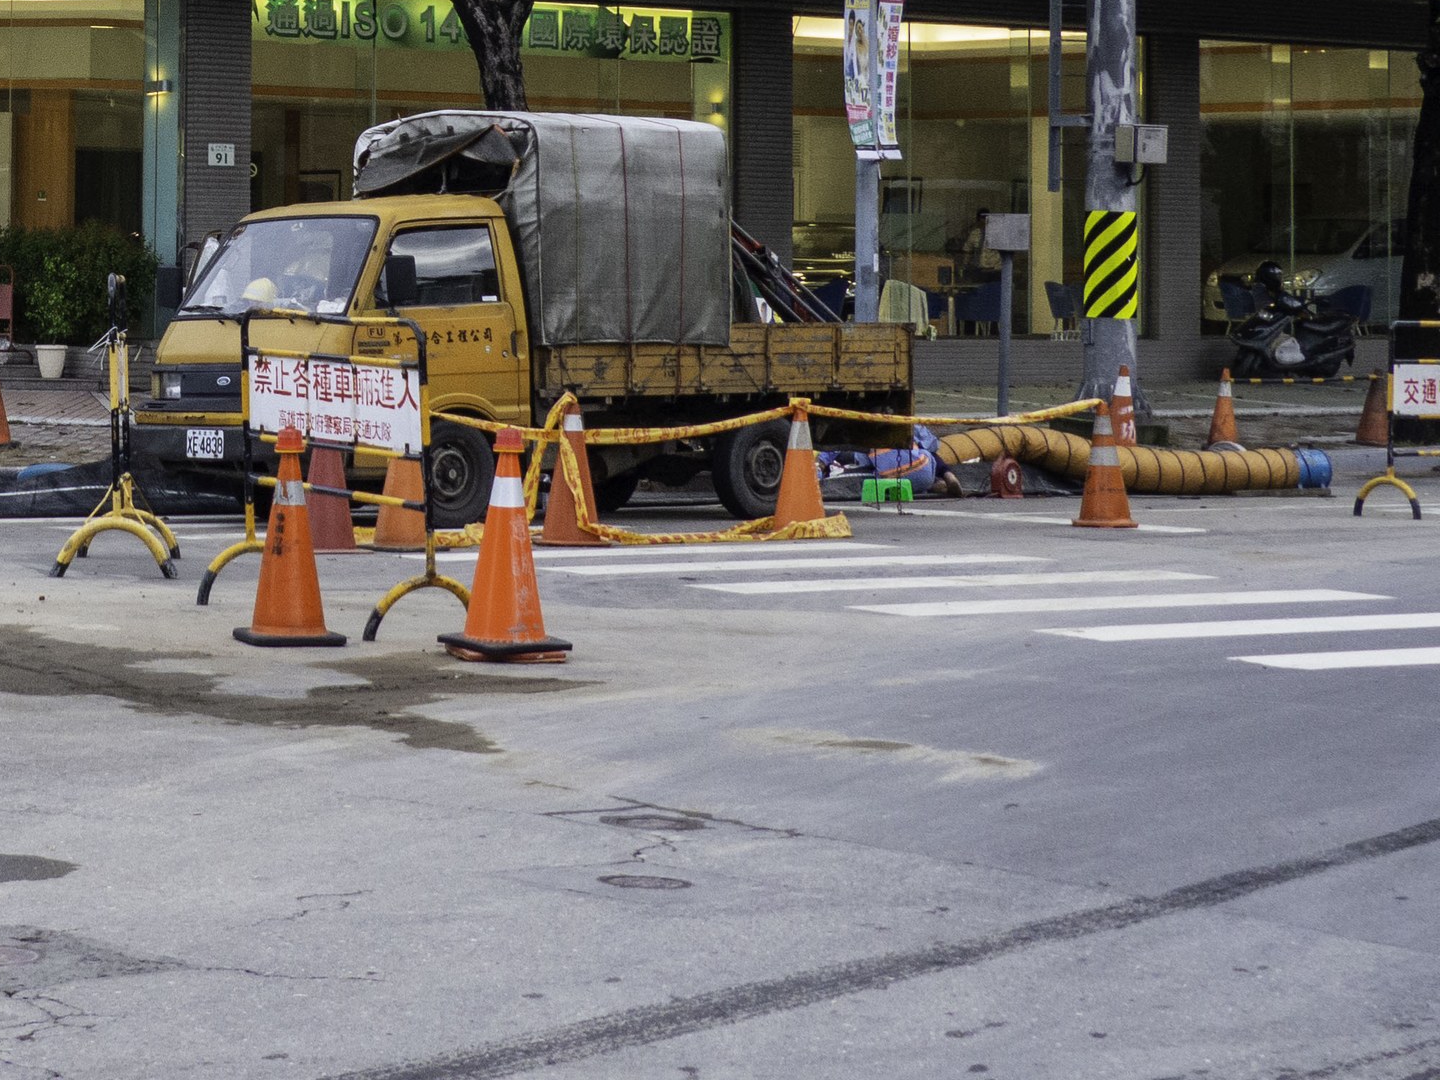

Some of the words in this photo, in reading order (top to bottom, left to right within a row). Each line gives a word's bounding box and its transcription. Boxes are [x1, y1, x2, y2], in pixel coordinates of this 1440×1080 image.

[529, 9, 722, 58] 國際環保認證
[215, 152, 228, 165] 91
[254, 357, 419, 411] 禁止各種車輛進入
[1403, 378, 1437, 405] 交通
